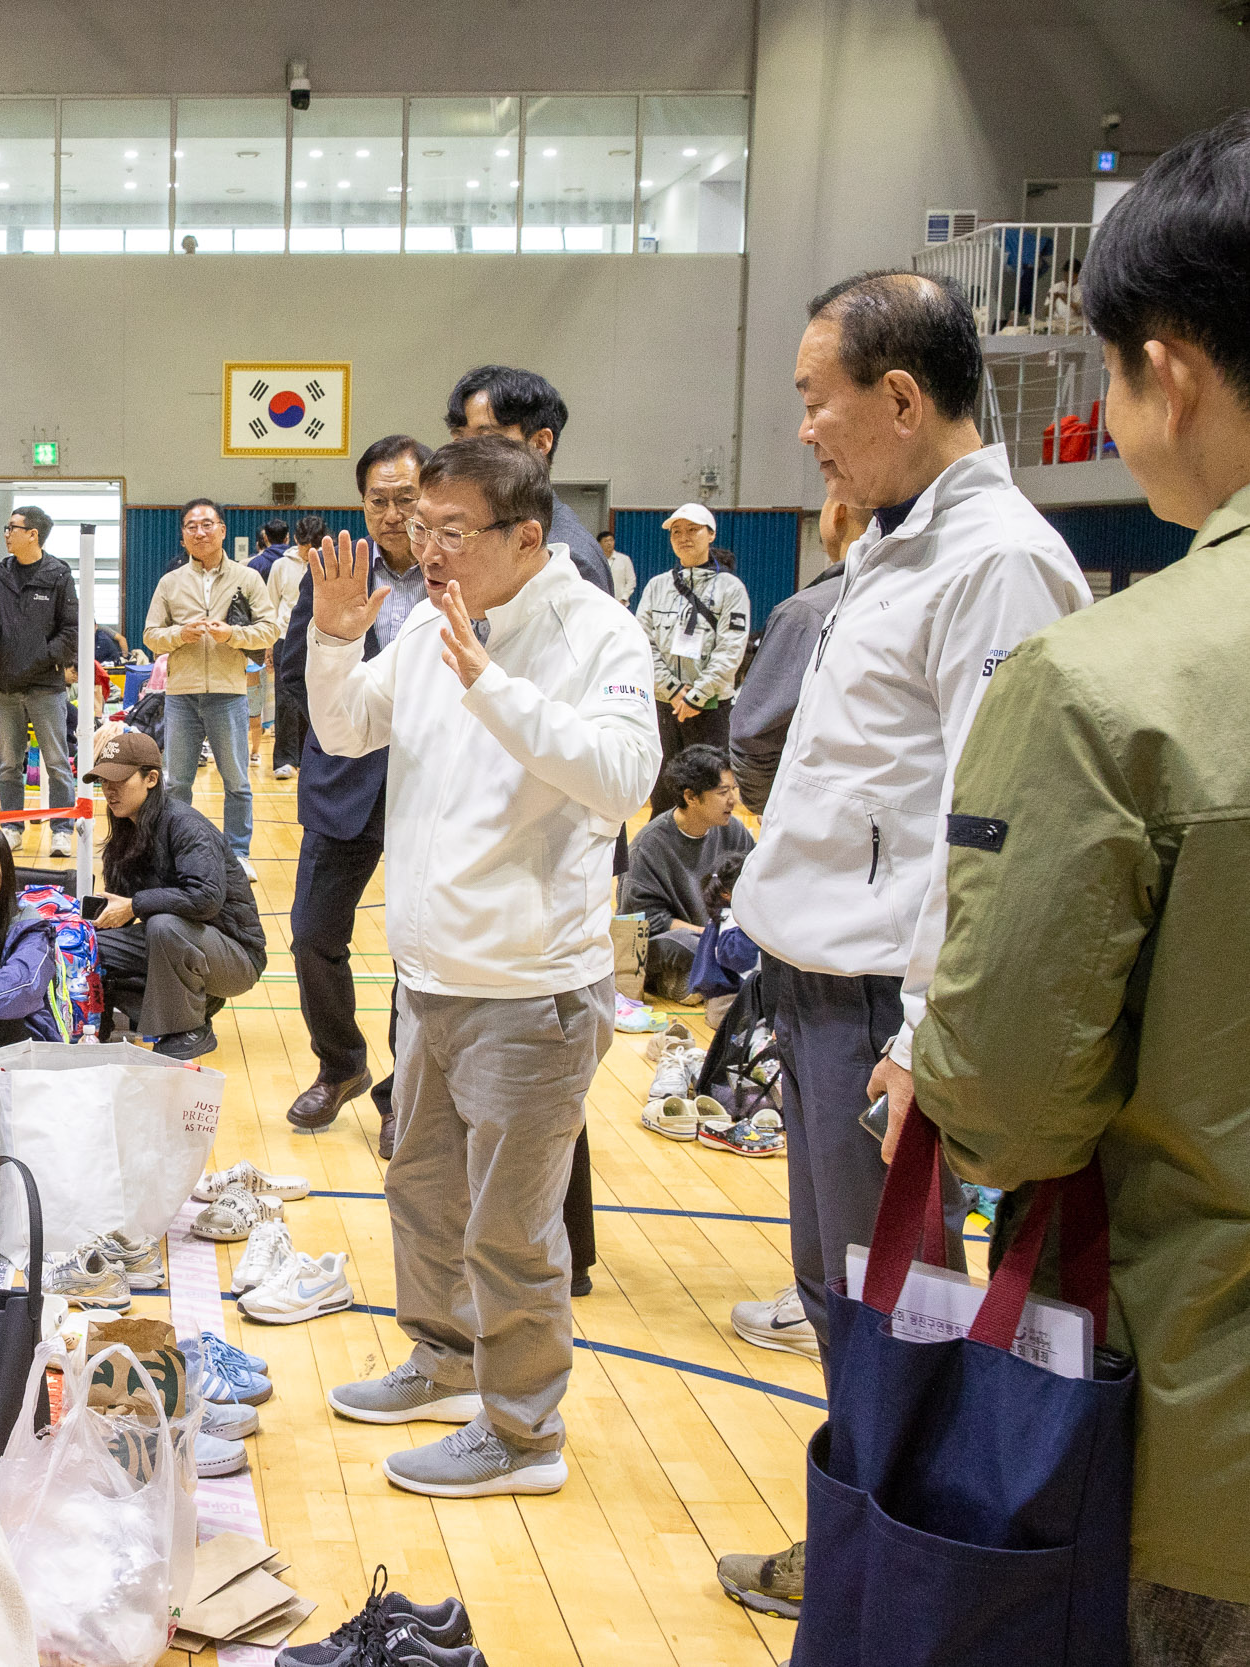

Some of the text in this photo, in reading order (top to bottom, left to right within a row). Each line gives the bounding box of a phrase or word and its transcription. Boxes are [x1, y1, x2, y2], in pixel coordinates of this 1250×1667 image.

[194, 1100, 221, 1114] JUST
[184, 1123, 216, 1134] AS THE
